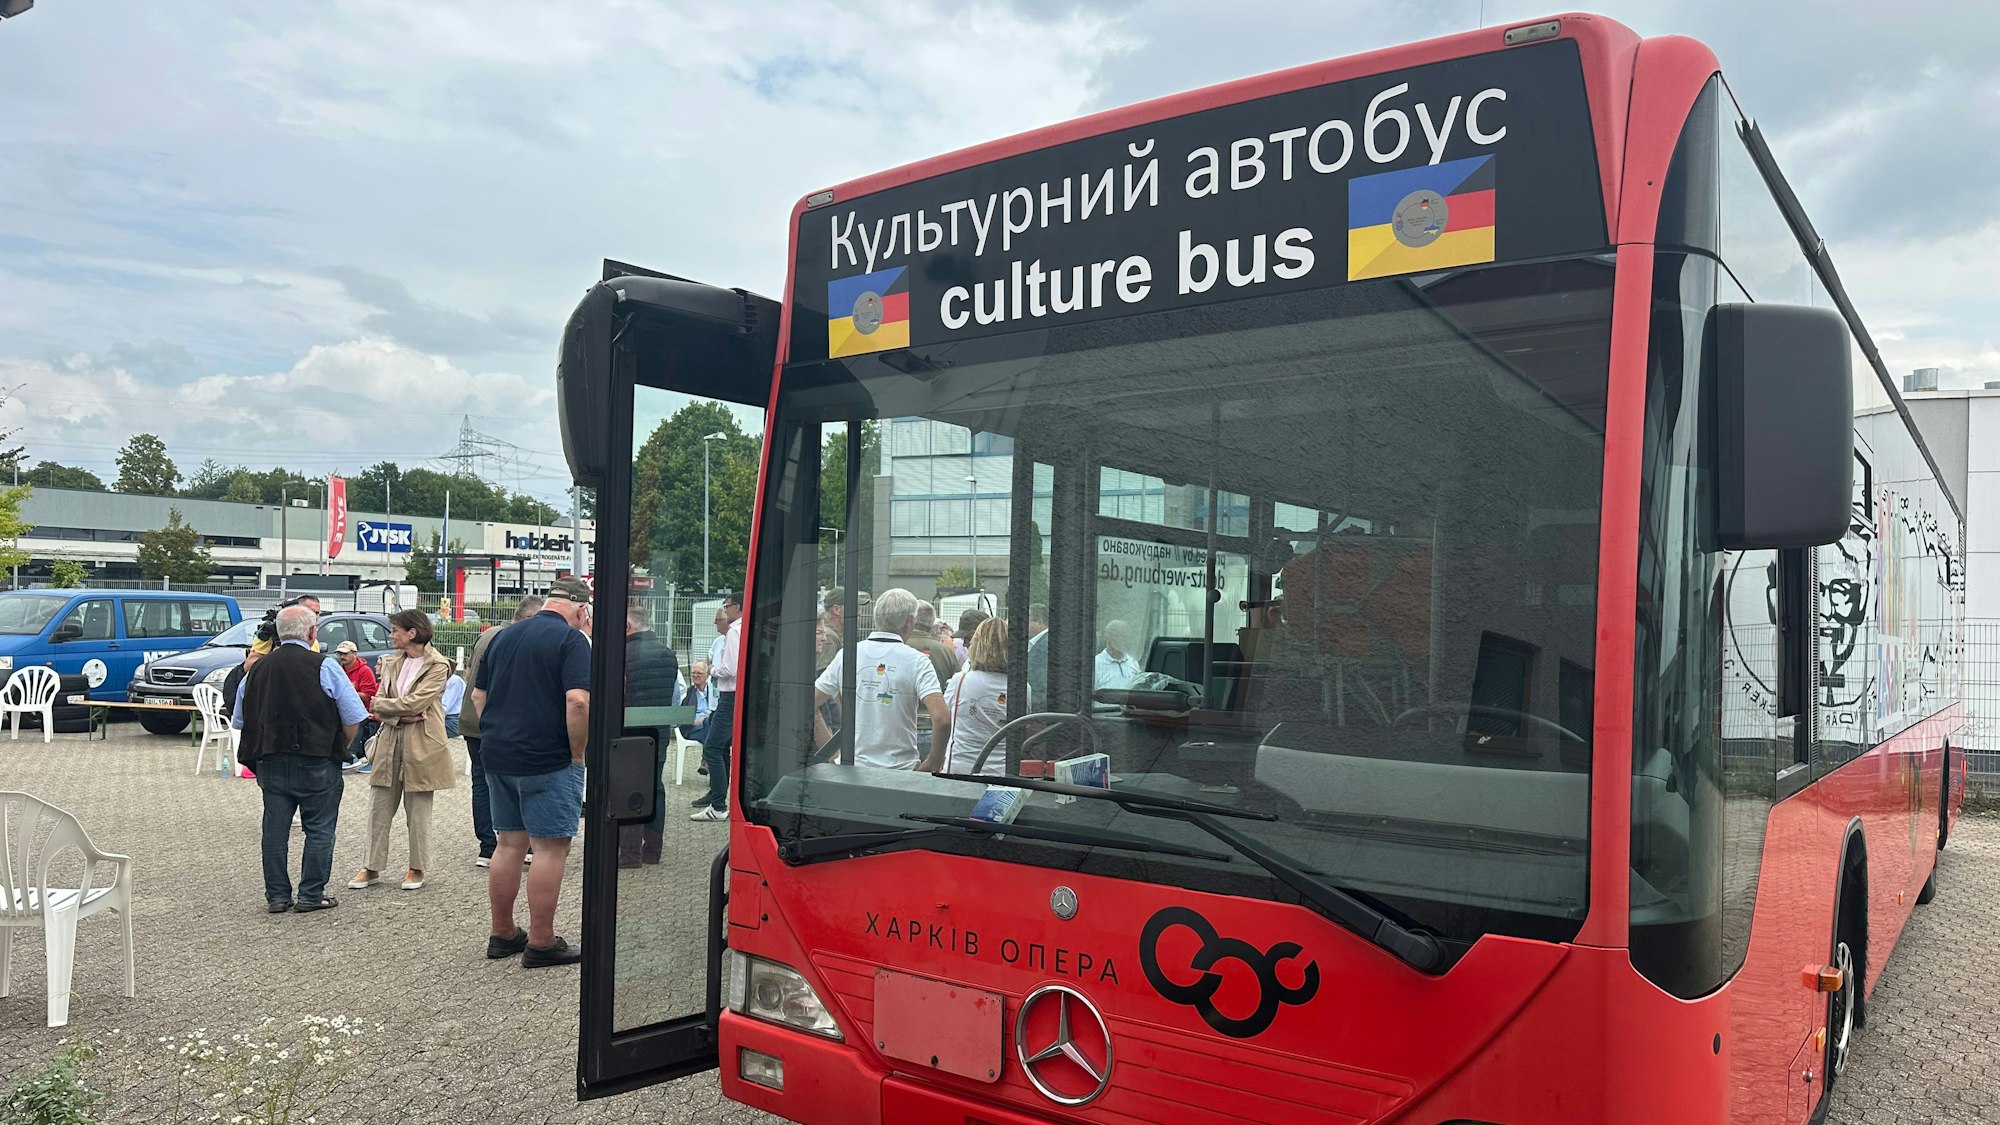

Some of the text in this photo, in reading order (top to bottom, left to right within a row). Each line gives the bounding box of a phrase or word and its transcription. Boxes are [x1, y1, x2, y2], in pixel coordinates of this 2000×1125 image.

[830, 82, 1508, 275] Культурний автобус
[939, 227, 1316, 331] culture bus
[334, 496, 345, 543] SALE
[369, 528, 411, 546] JYSK
[865, 911, 1120, 986] ХАРКІВ ОПЕРА
